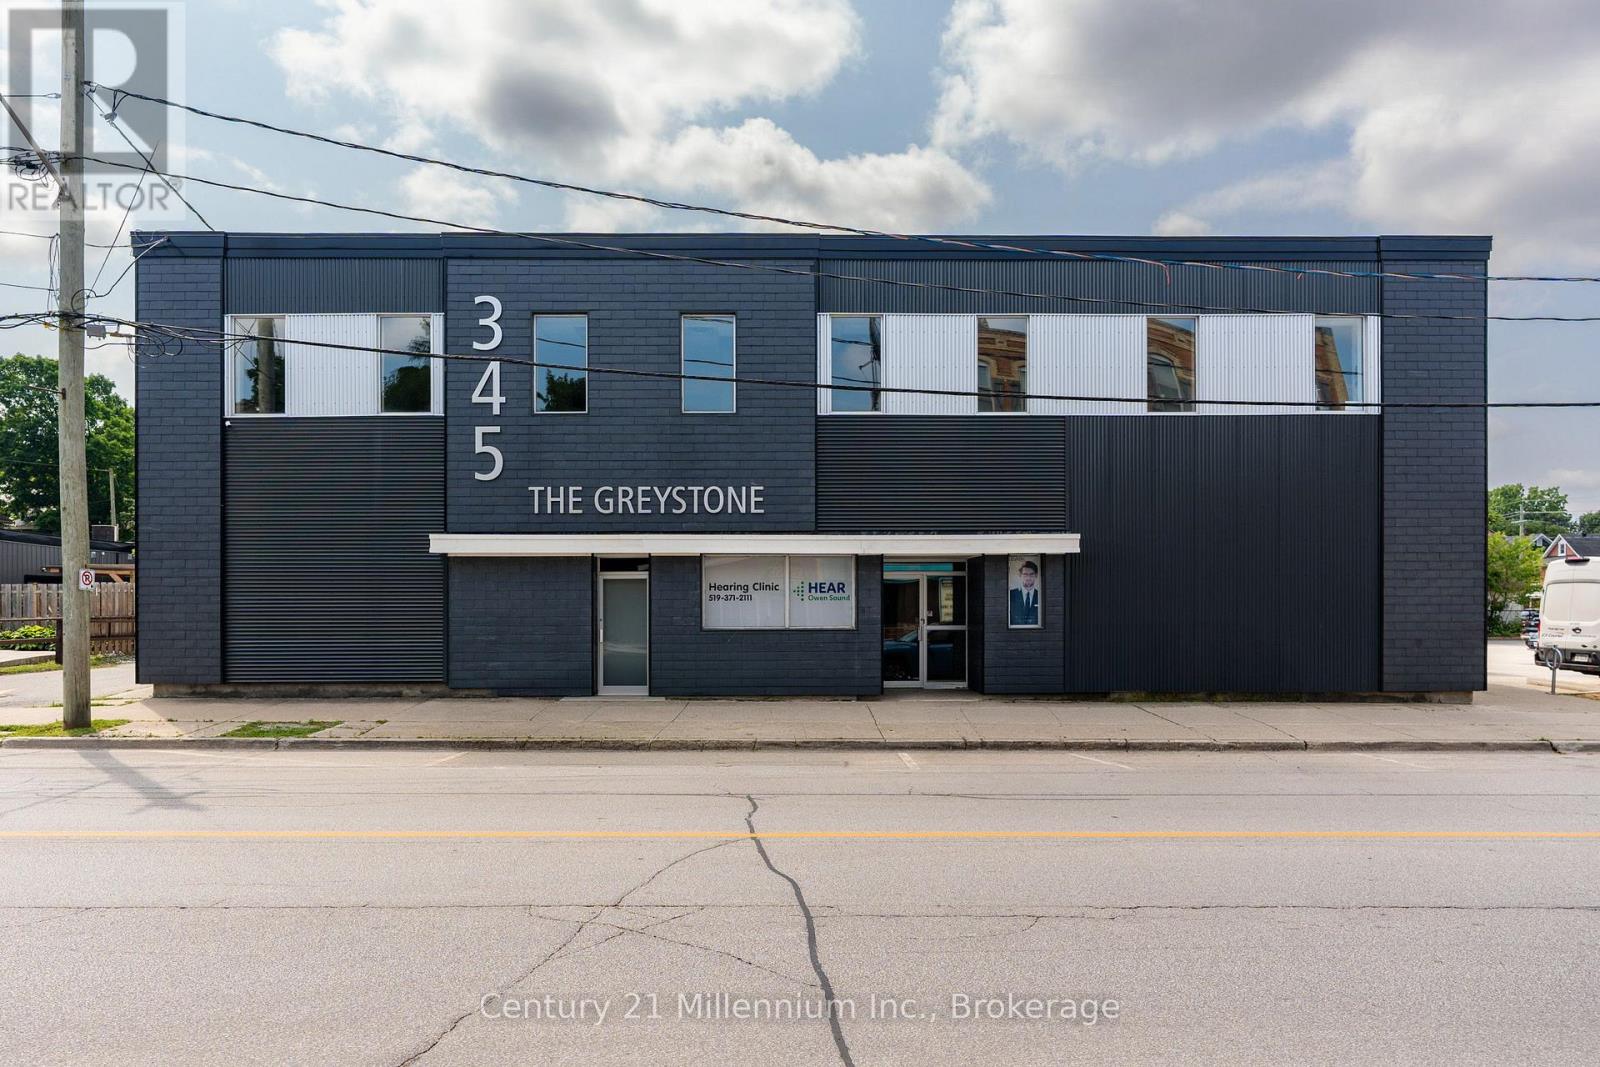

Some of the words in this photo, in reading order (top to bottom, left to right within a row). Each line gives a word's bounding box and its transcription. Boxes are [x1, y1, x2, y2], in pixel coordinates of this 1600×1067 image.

[528, 486, 583, 514] THE
[594, 485, 765, 514] GREYSTONE
[708, 582, 749, 593] Hearing
[752, 582, 780, 592] Clinic
[808, 582, 846, 594] HEAR
[708, 594, 753, 602] 519-371-2111
